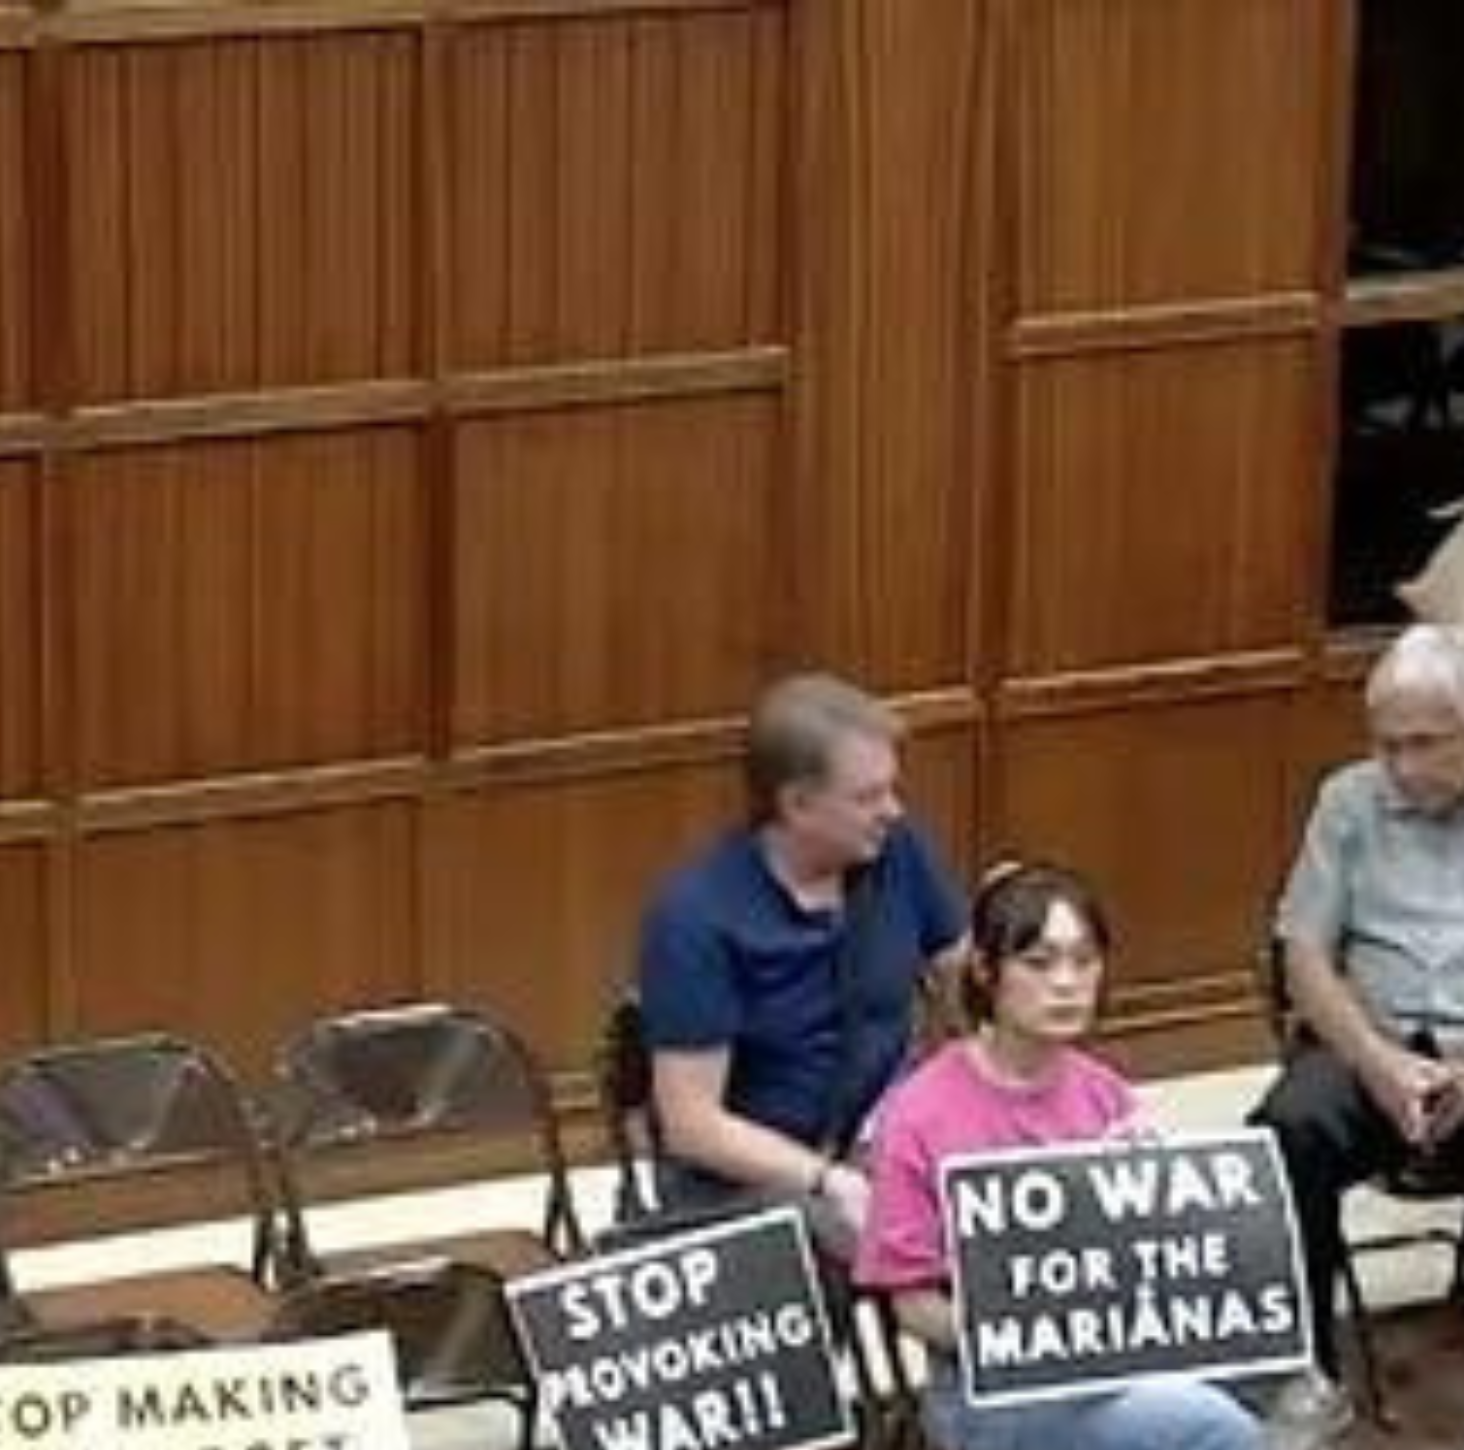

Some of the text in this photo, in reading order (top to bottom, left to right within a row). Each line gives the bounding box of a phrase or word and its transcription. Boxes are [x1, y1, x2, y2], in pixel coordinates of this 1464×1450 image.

[954, 1152, 1263, 1238] NO WAR
[562, 1248, 718, 1341] STOP
[1009, 1231, 1230, 1299] FOR THE
[116, 1362, 370, 1430] MAKING
